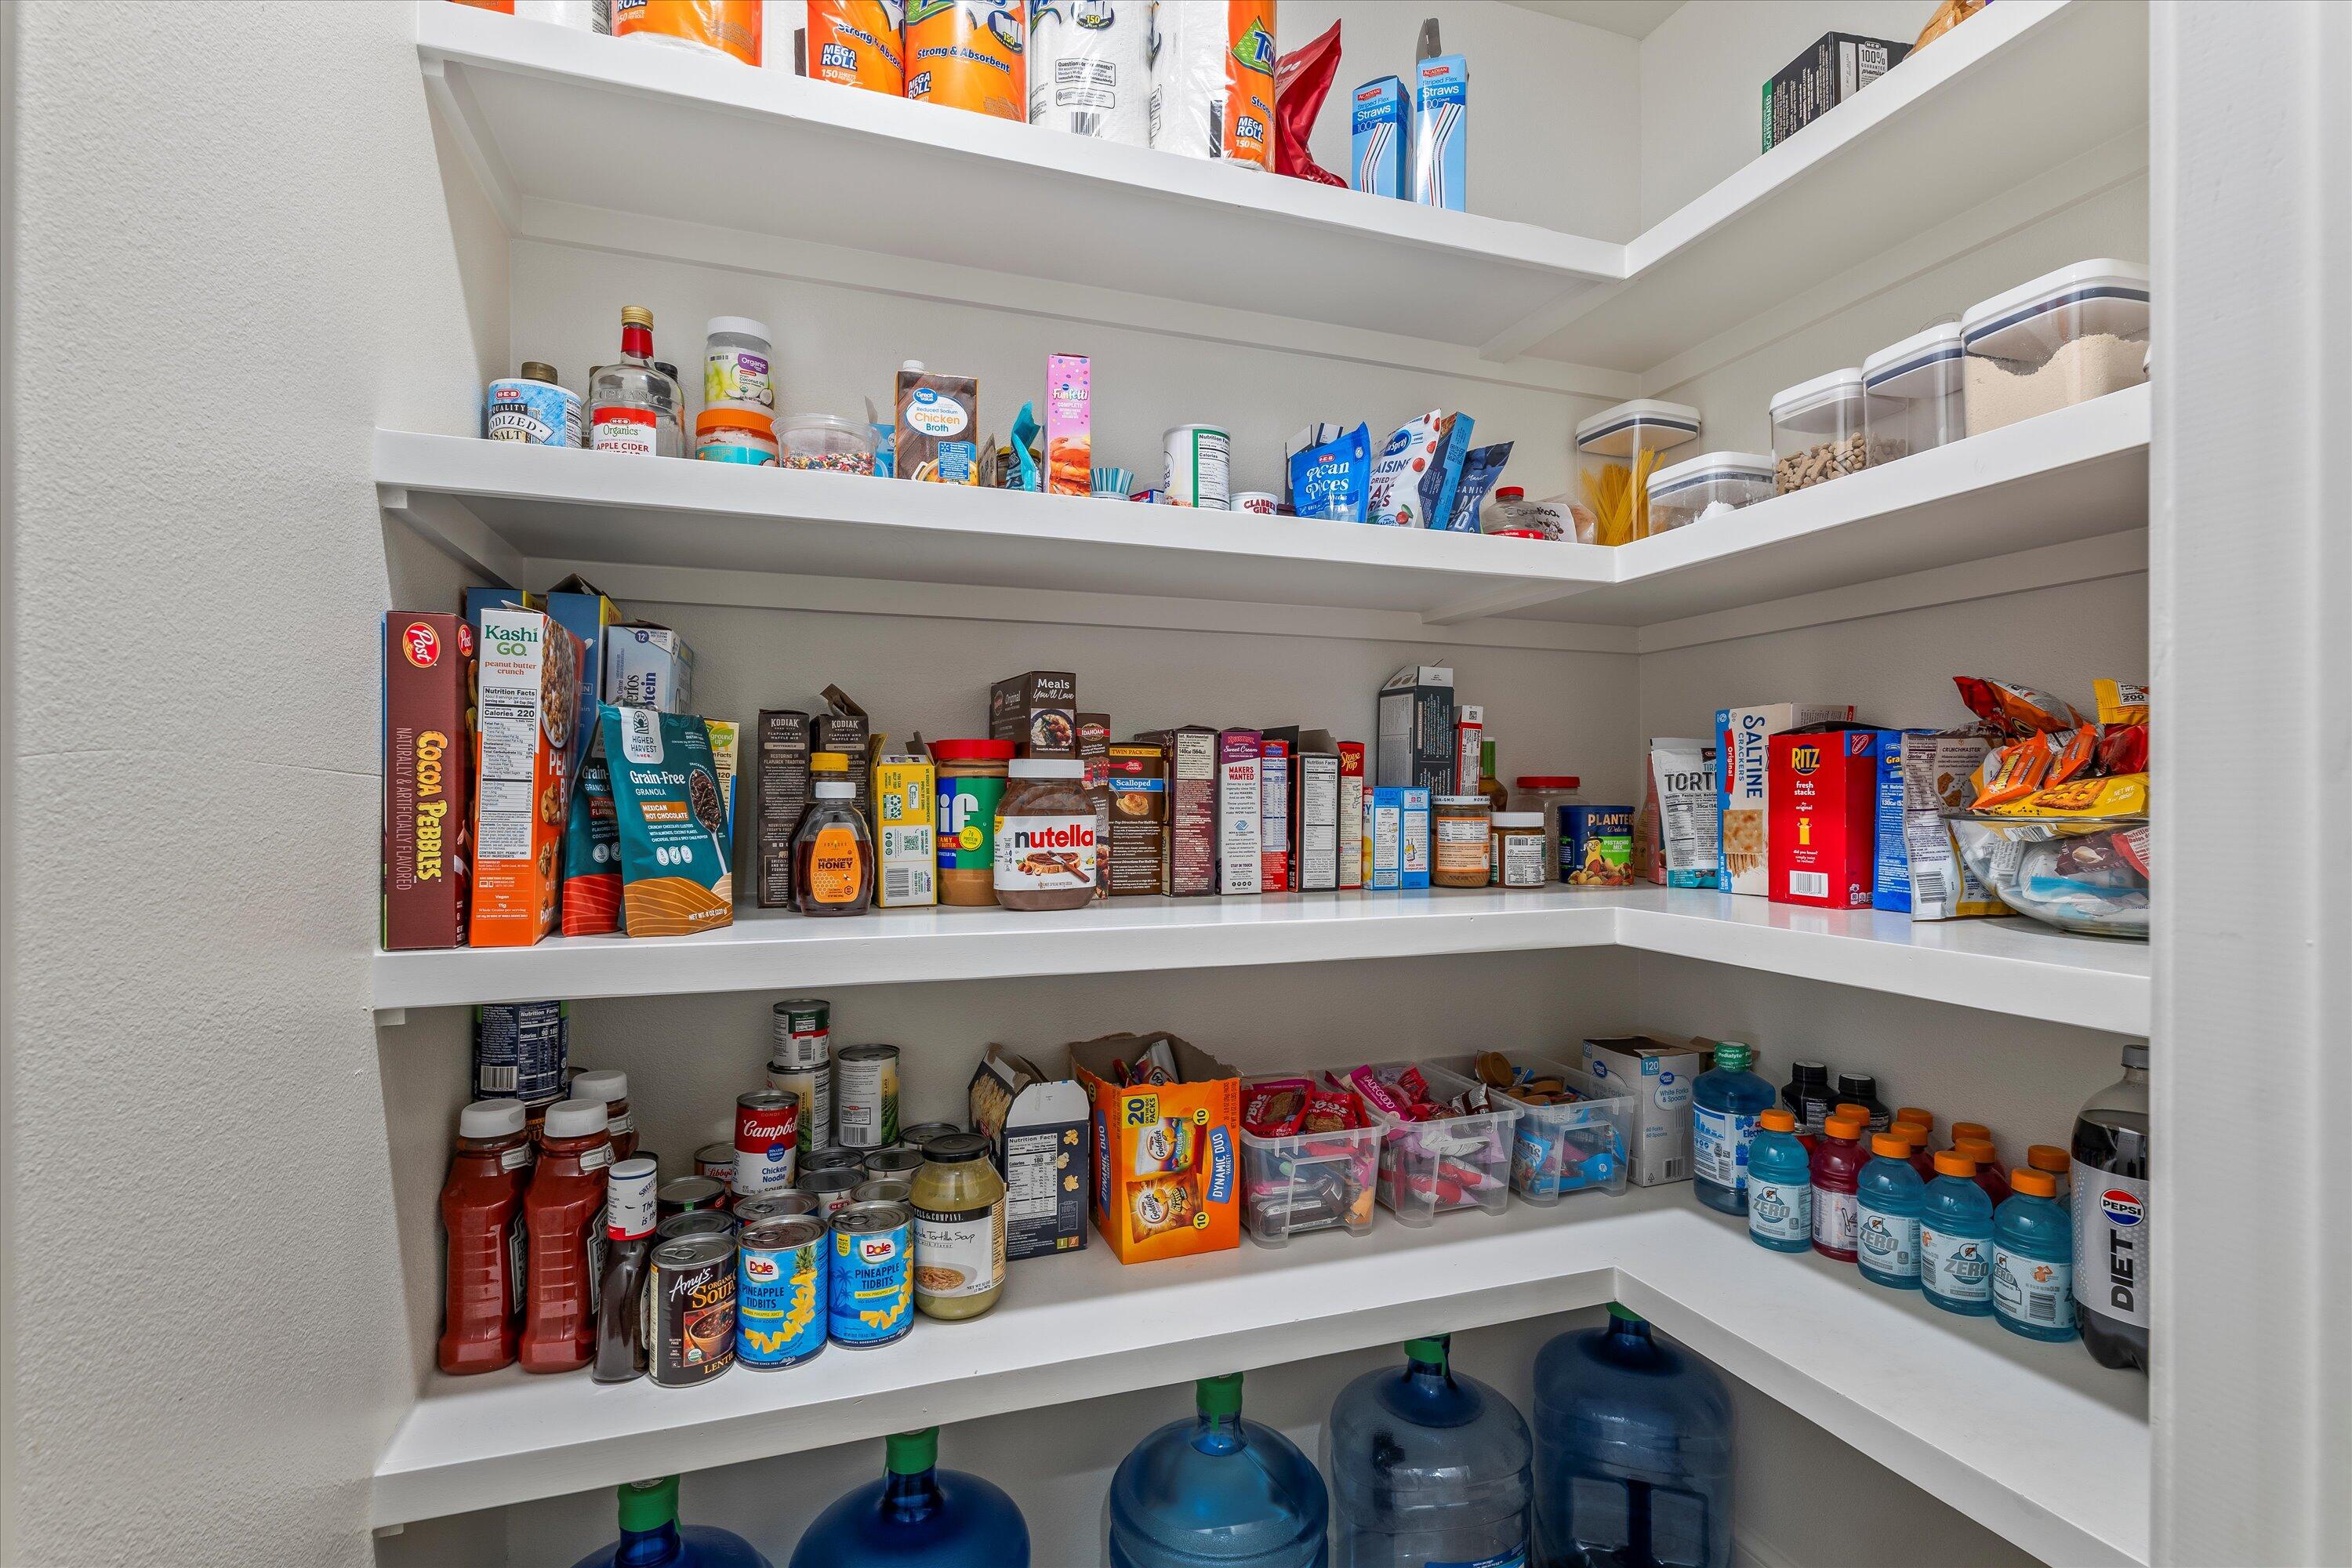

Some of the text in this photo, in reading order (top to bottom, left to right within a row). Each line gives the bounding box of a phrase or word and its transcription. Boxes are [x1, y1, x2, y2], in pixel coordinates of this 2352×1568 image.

[1086, 15, 1101, 24] 150
[824, 45, 855, 60] MEGA
[1861, 49, 1886, 65] 100%
[822, 54, 856, 70] ROLL
[916, 47, 1010, 74] Strong & Absorbent
[1861, 63, 1886, 71] GUARANTEE
[822, 69, 838, 78] 150
[1423, 67, 1447, 76] ACADIAN
[909, 72, 931, 90] MEGA
[1423, 78, 1444, 87] Striped
[909, 83, 931, 100] ROLL
[1359, 89, 1380, 100] ACADIAN
[1423, 85, 1459, 98] Straws
[1358, 96, 1389, 111] Striped Flex
[1357, 105, 1391, 122] Straws
[1239, 118, 1264, 132] MEGA
[1236, 126, 1264, 142] ROLL
[1236, 140, 1250, 148] 150
[741, 357, 766, 369] Organic
[1052, 389, 1088, 401] Funfetti
[492, 405, 526, 414] QUALITY
[914, 412, 960, 424] Chicken
[603, 424, 638, 437] Organics
[926, 423, 949, 432] Broth
[622, 443, 649, 453] CIDER
[485, 624, 538, 642] Kashi
[410, 629, 434, 665] Post
[1038, 678, 1069, 689] Meals
[1033, 689, 1075, 702] You'll Love
[771, 718, 799, 728] KODIAK
[831, 720, 858, 729] KODIAK
[632, 735, 654, 744] HIGHER
[710, 734, 733, 742] ground
[1853, 735, 1867, 753] NABISCO
[1341, 752, 1361, 767] Stove
[1742, 714, 1766, 799] SALTINE
[1791, 747, 1820, 769] RITZ
[1345, 761, 1358, 771] Top
[630, 770, 686, 785] Grain-Free
[416, 730, 448, 881] COCOA PEBBLES
[1014, 824, 1094, 849] nutella
[1646, 1061, 1659, 1070] 120
[1363, 1074, 1396, 1109] MADEGOOD
[1128, 1098, 1144, 1126] 20
[1199, 1109, 1206, 1123] 10
[1154, 1129, 1165, 1158] Goldfish
[762, 1165, 787, 1175] Chicken
[1212, 1134, 1223, 1198] DYNAMIC DUO
[762, 1174, 786, 1183] Noodle
[639, 1182, 652, 1197] SWEET
[642, 1201, 653, 1213] The
[1150, 1193, 1159, 1220] Goldfish
[1753, 1197, 1791, 1218] ZERO
[2103, 1199, 2142, 1216] PEPSI
[1199, 1214, 1206, 1227] 10
[1860, 1227, 1899, 1251] ZERO
[866, 1243, 891, 1254] Dole
[750, 1261, 774, 1273] Dole
[855, 1265, 899, 1279] PINEAPPLE
[1944, 1259, 1989, 1277] ZERO
[2111, 1229, 2134, 1312] DIET
[862, 1276, 894, 1290] TIDBITS
[742, 1284, 784, 1298] PINEAPPLE
[746, 1298, 777, 1309] TIDBITS
